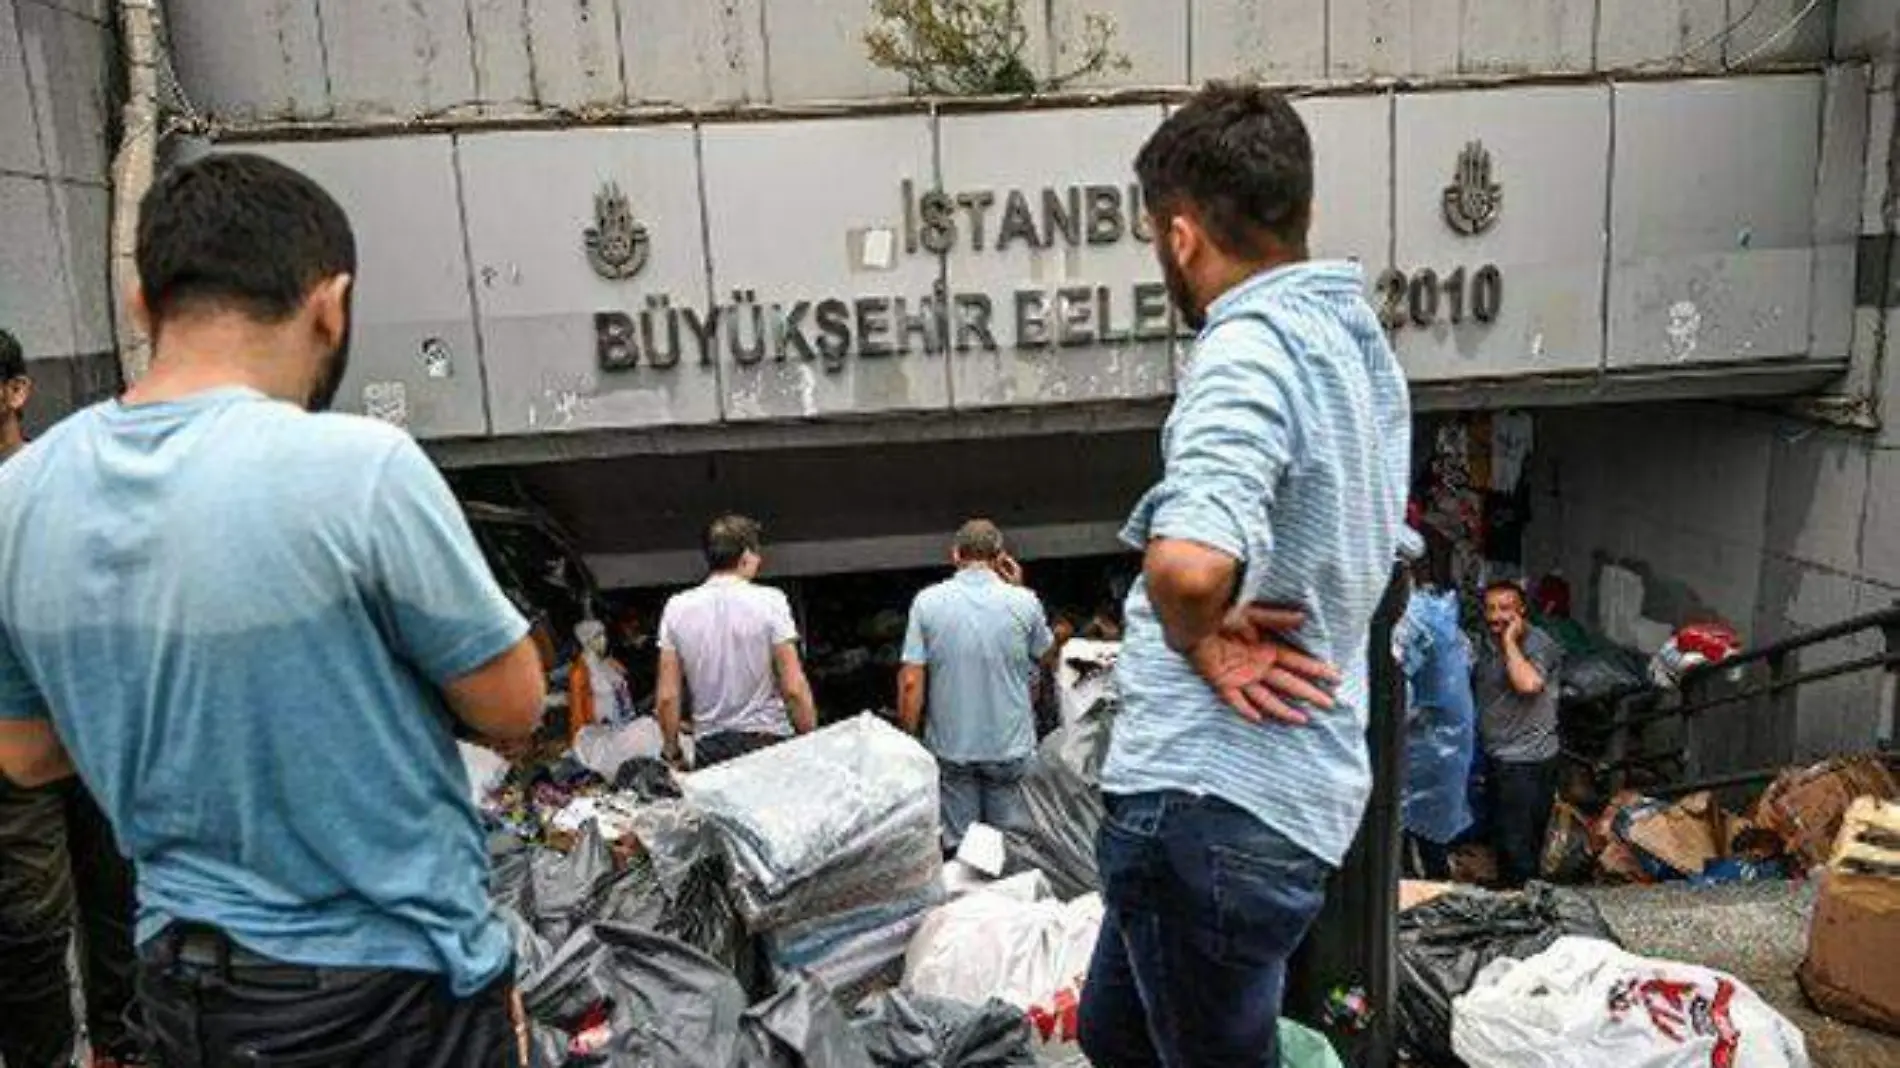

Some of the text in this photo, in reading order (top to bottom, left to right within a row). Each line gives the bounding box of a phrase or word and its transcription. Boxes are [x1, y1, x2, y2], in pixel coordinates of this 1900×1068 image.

[593, 264, 1503, 374] BÜYÜKŞEHİR BELE 2010
